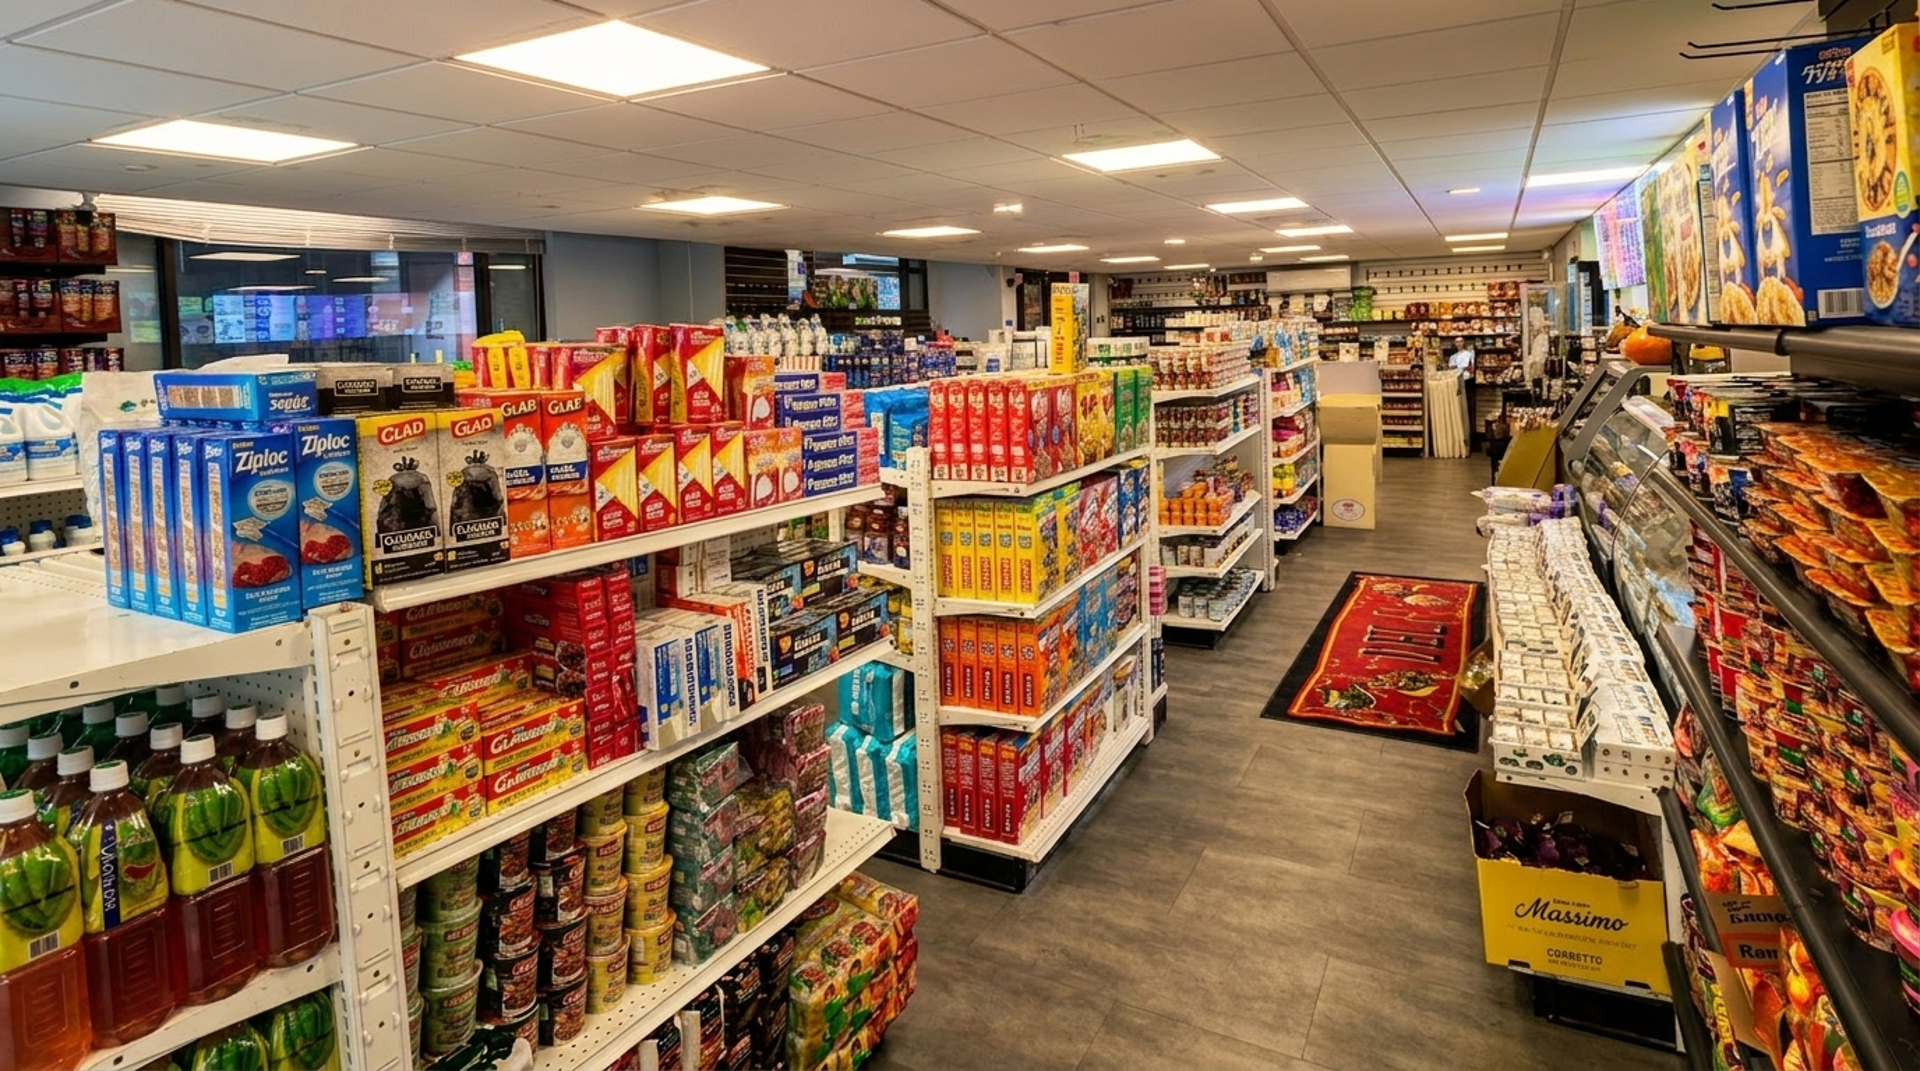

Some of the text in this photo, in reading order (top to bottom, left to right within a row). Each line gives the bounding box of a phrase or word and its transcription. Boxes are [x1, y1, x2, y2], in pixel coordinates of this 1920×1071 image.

[301, 433, 350, 458] Ziploc
[235, 448, 289, 475] Ziploc
[1514, 897, 1629, 931] Massimo
